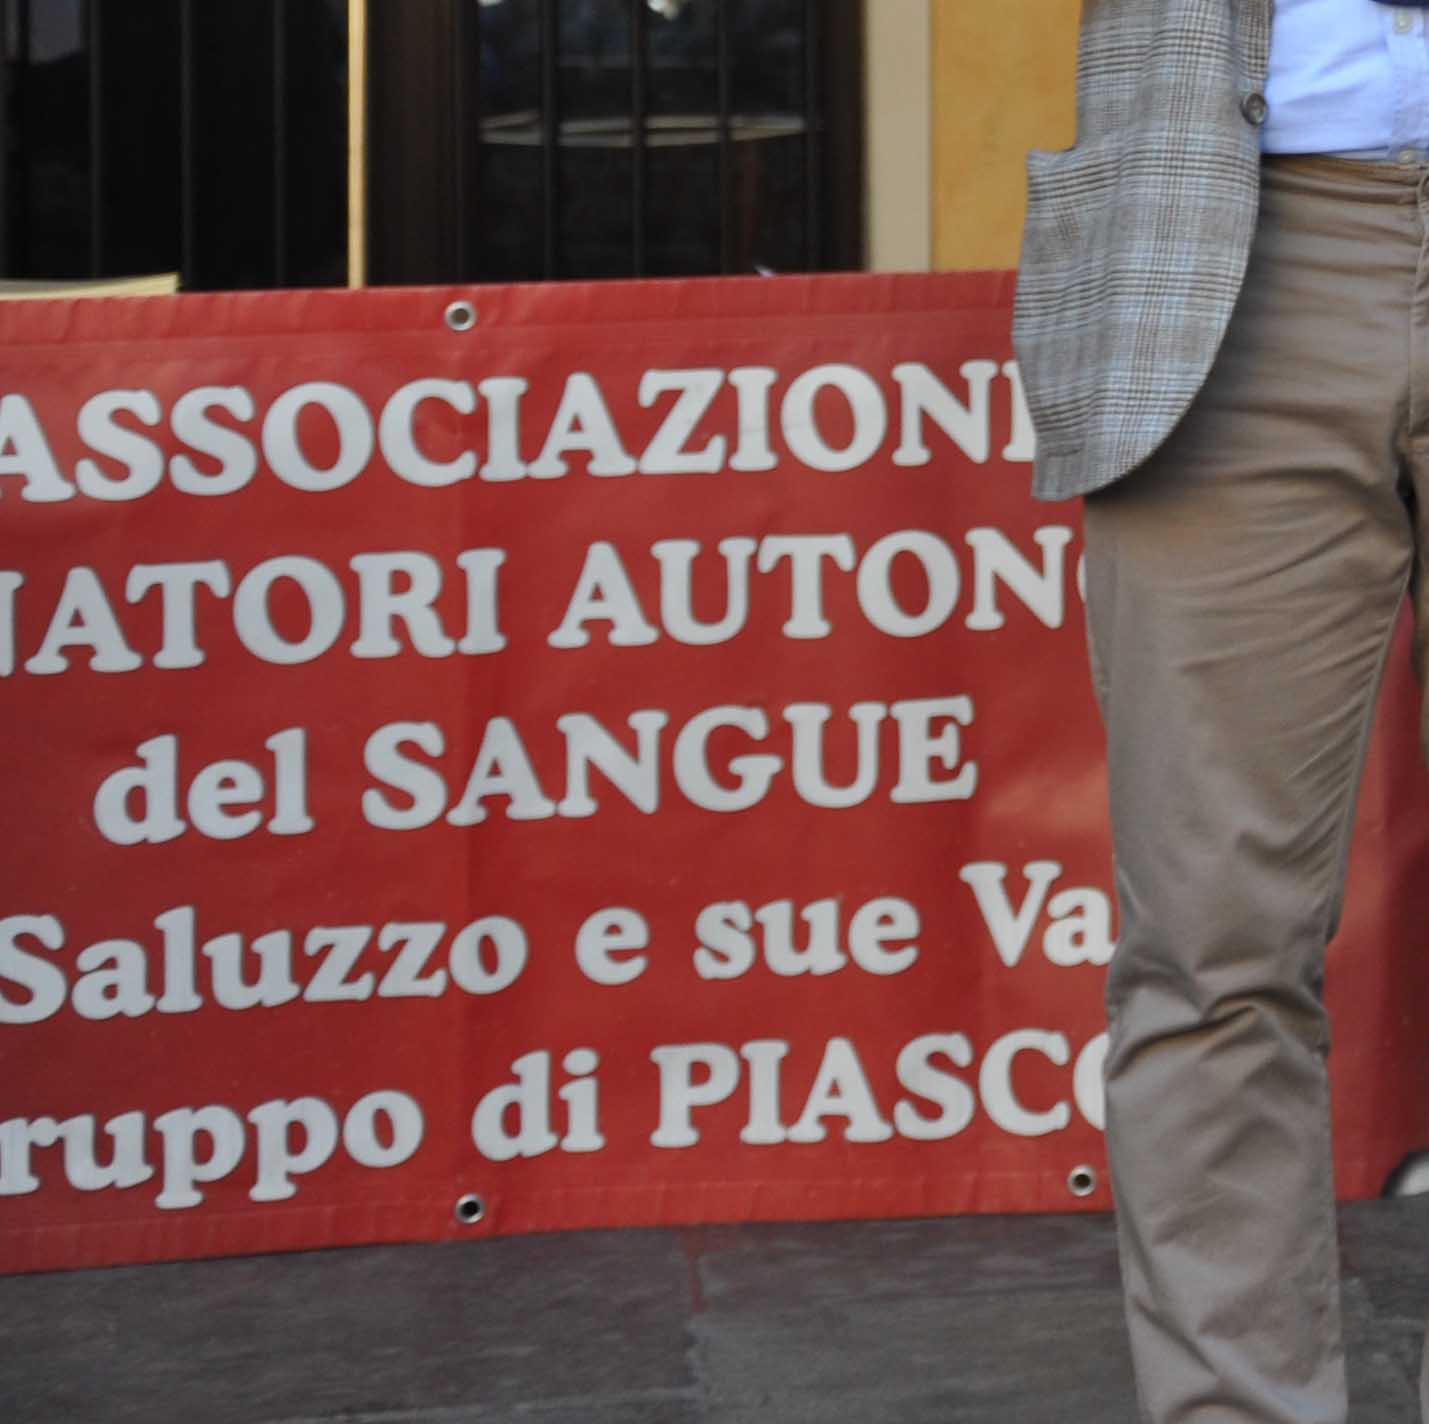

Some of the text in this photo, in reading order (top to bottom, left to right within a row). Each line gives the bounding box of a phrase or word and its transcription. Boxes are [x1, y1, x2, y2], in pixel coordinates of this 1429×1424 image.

[548, 524, 1086, 650] AUTON
[93, 694, 979, 847] del SANGUE
[0, 905, 527, 1025] Saluzzo
[575, 906, 649, 986] e
[694, 893, 923, 982] sue
[472, 1048, 603, 1163] di
